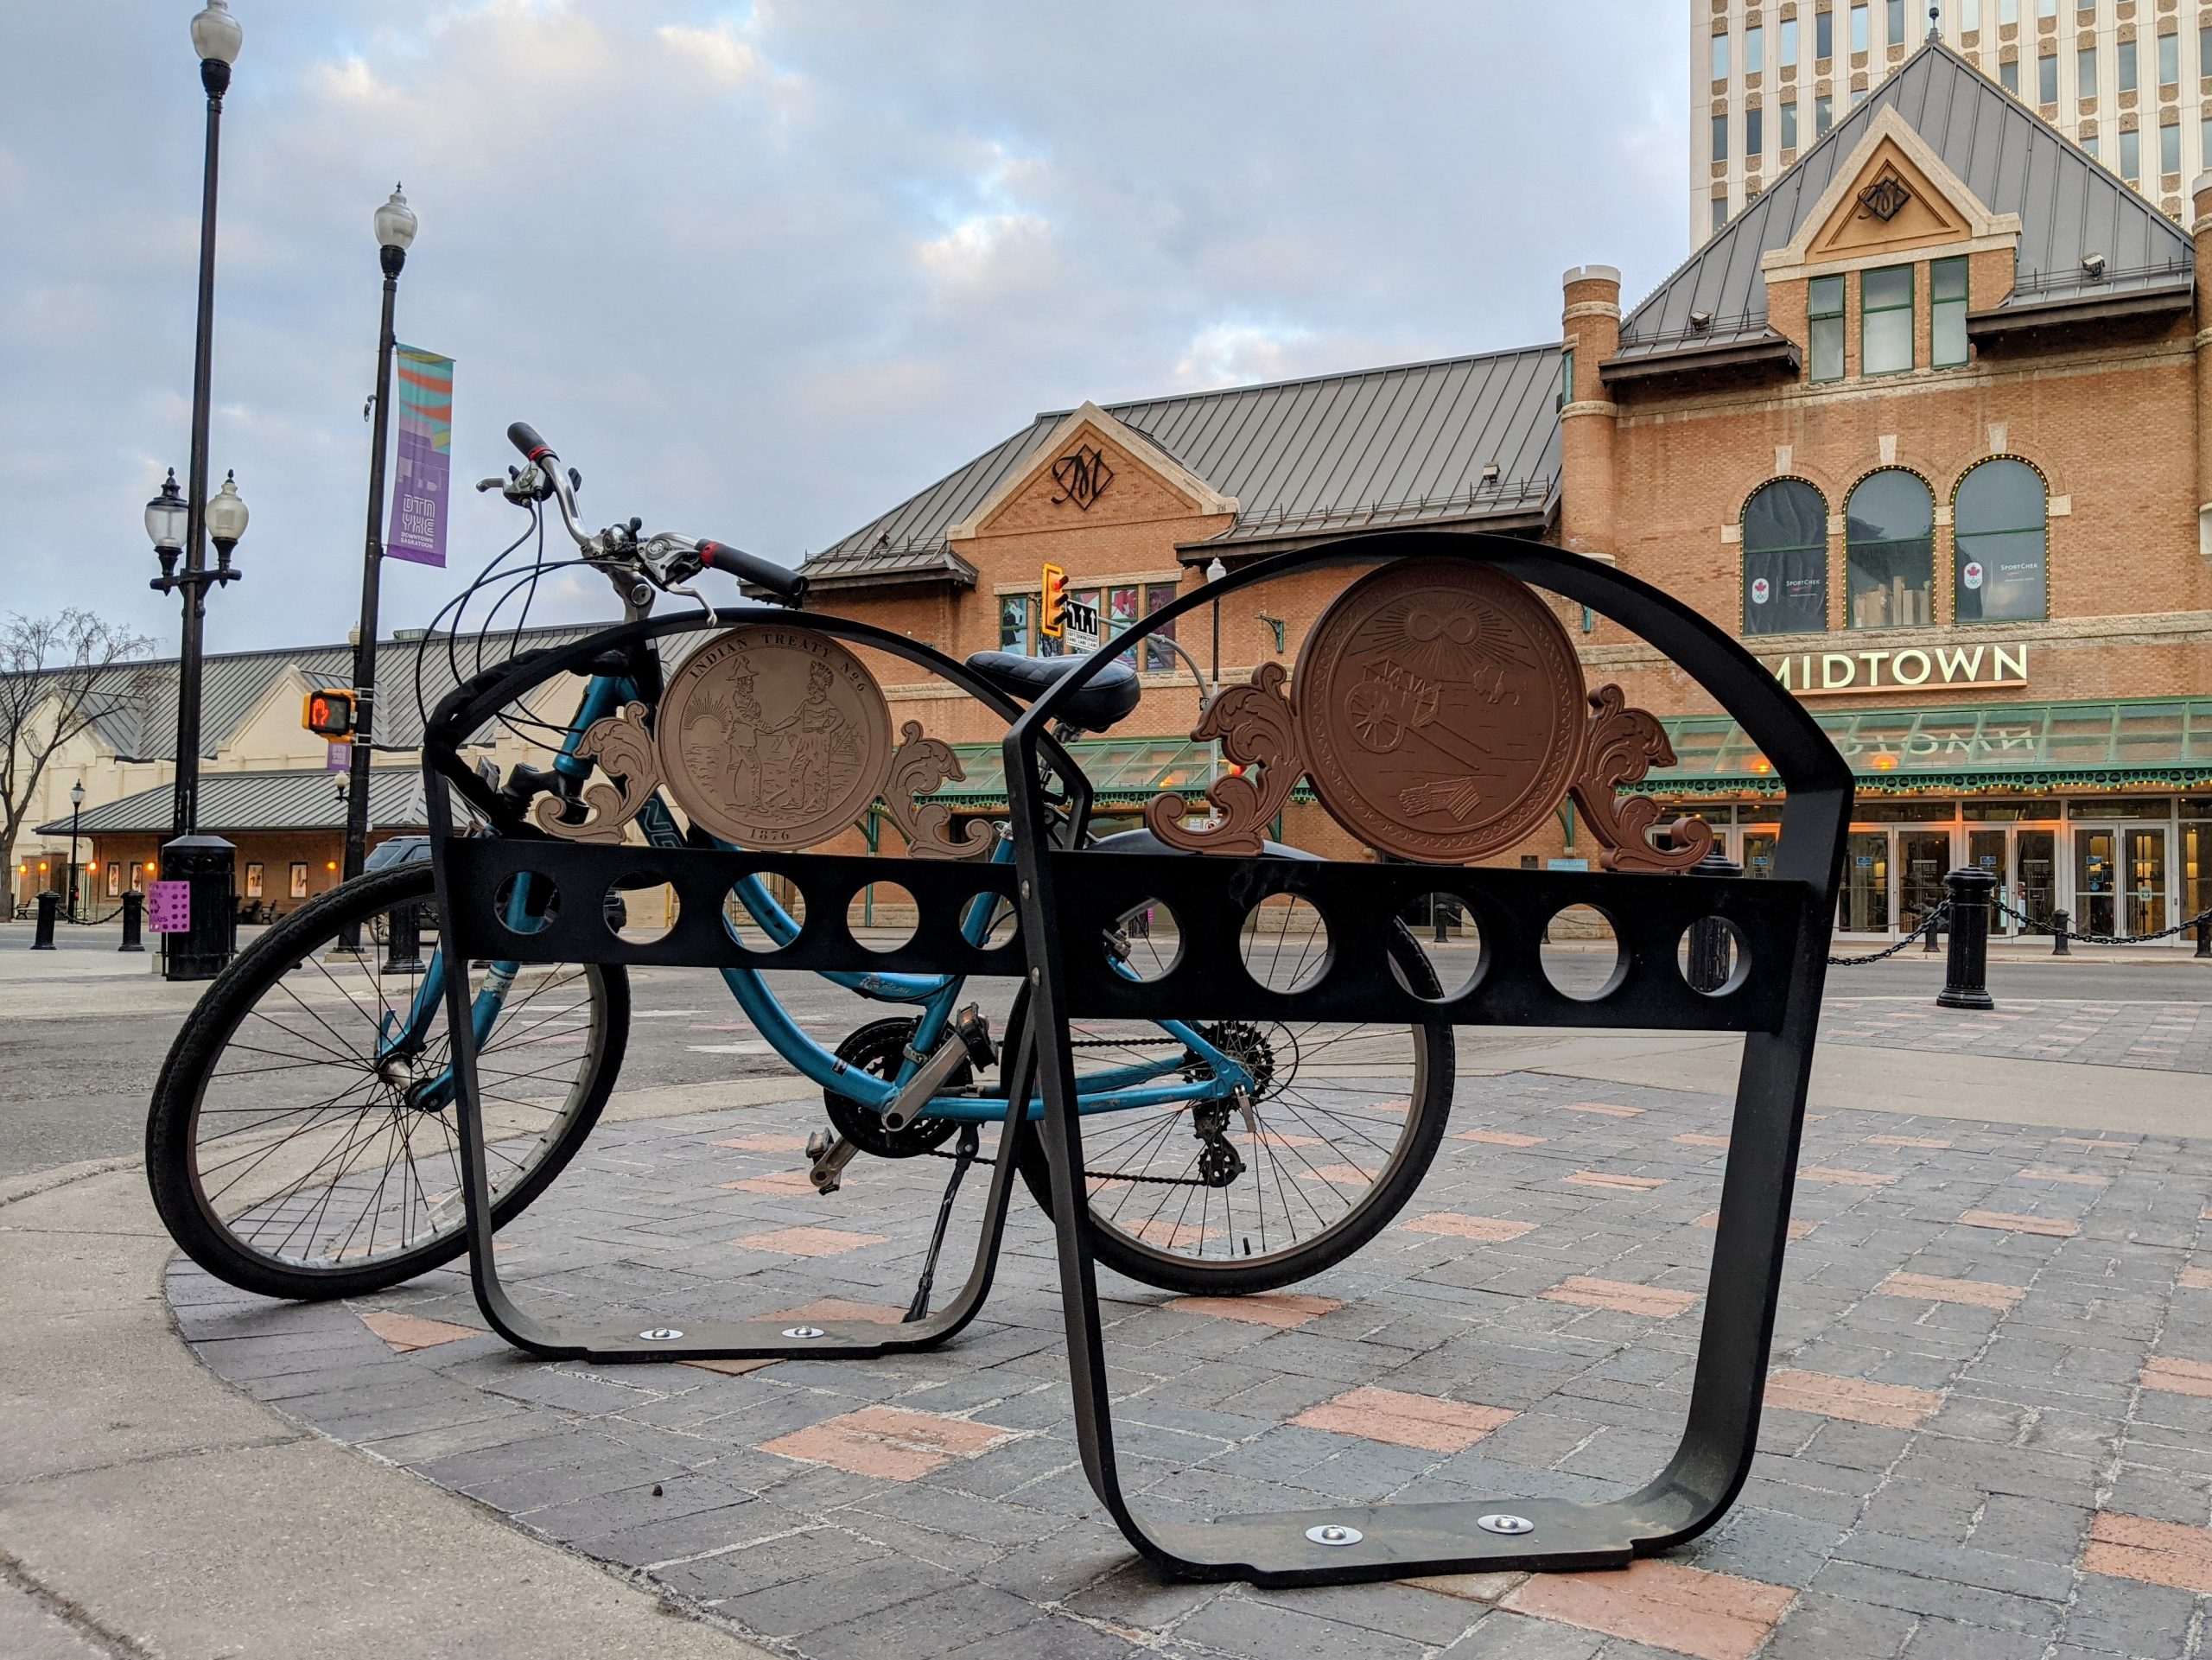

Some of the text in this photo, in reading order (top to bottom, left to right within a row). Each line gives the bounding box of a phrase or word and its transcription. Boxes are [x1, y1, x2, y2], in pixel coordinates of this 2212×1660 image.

[402, 512, 435, 537] YXE
[400, 537, 434, 549] SASKATOON
[401, 531, 434, 544] DOWNTOWN
[689, 637, 748, 679] INDIAN
[761, 633, 832, 658] TREATY
[750, 829, 790, 841] 1876
